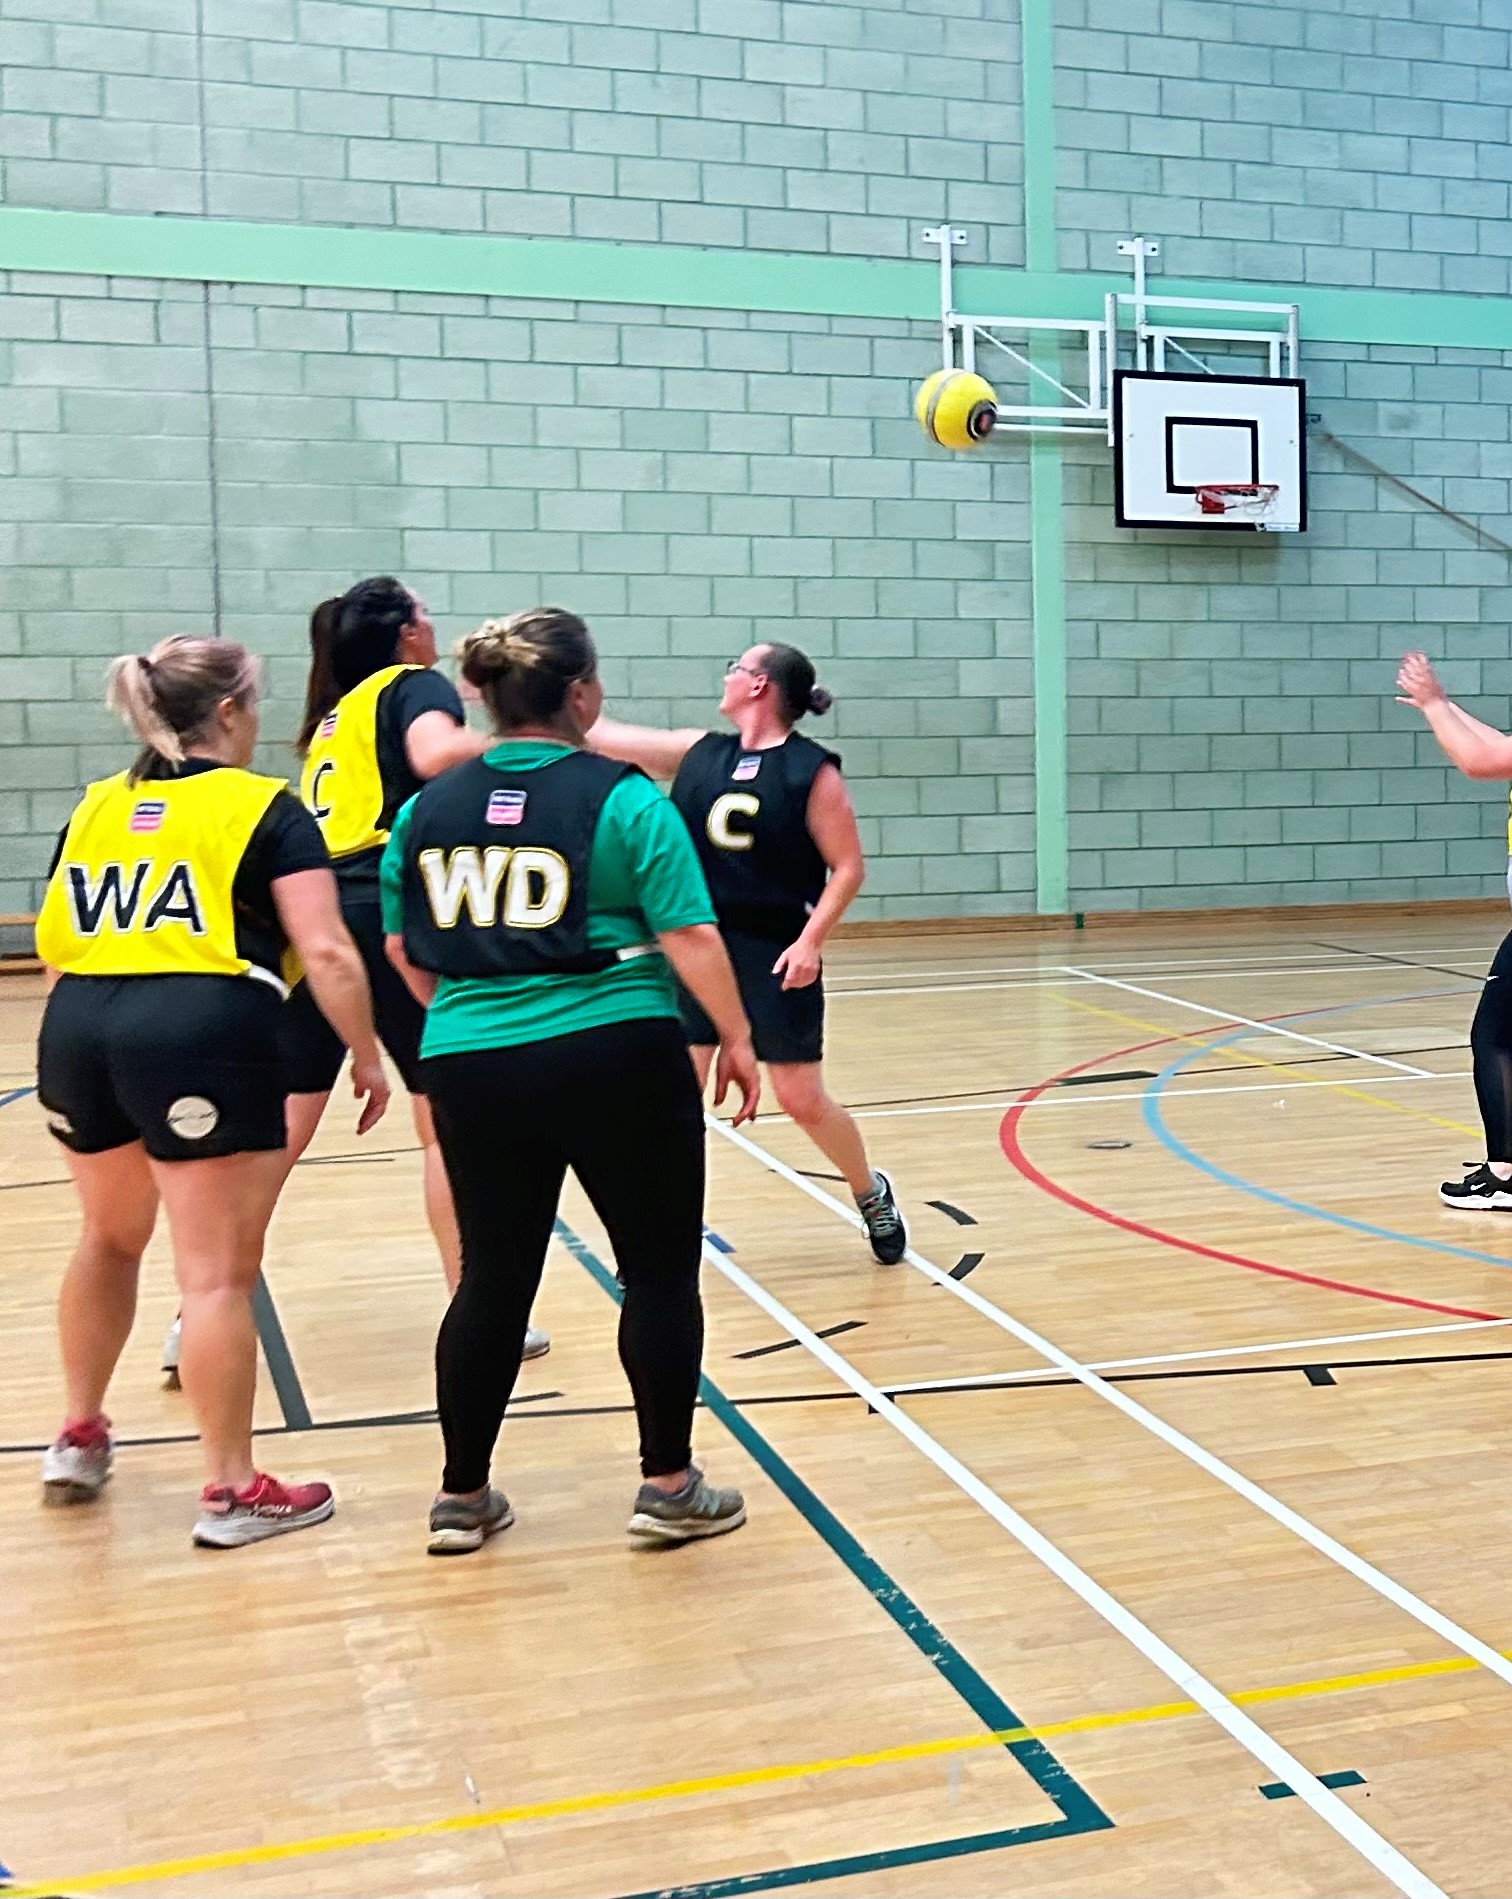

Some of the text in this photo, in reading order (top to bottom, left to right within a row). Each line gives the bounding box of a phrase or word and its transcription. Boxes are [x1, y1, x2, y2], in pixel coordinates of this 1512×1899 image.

[706, 793, 760, 851] C
[66, 860, 206, 935] WA
[418, 846, 571, 928] WD
